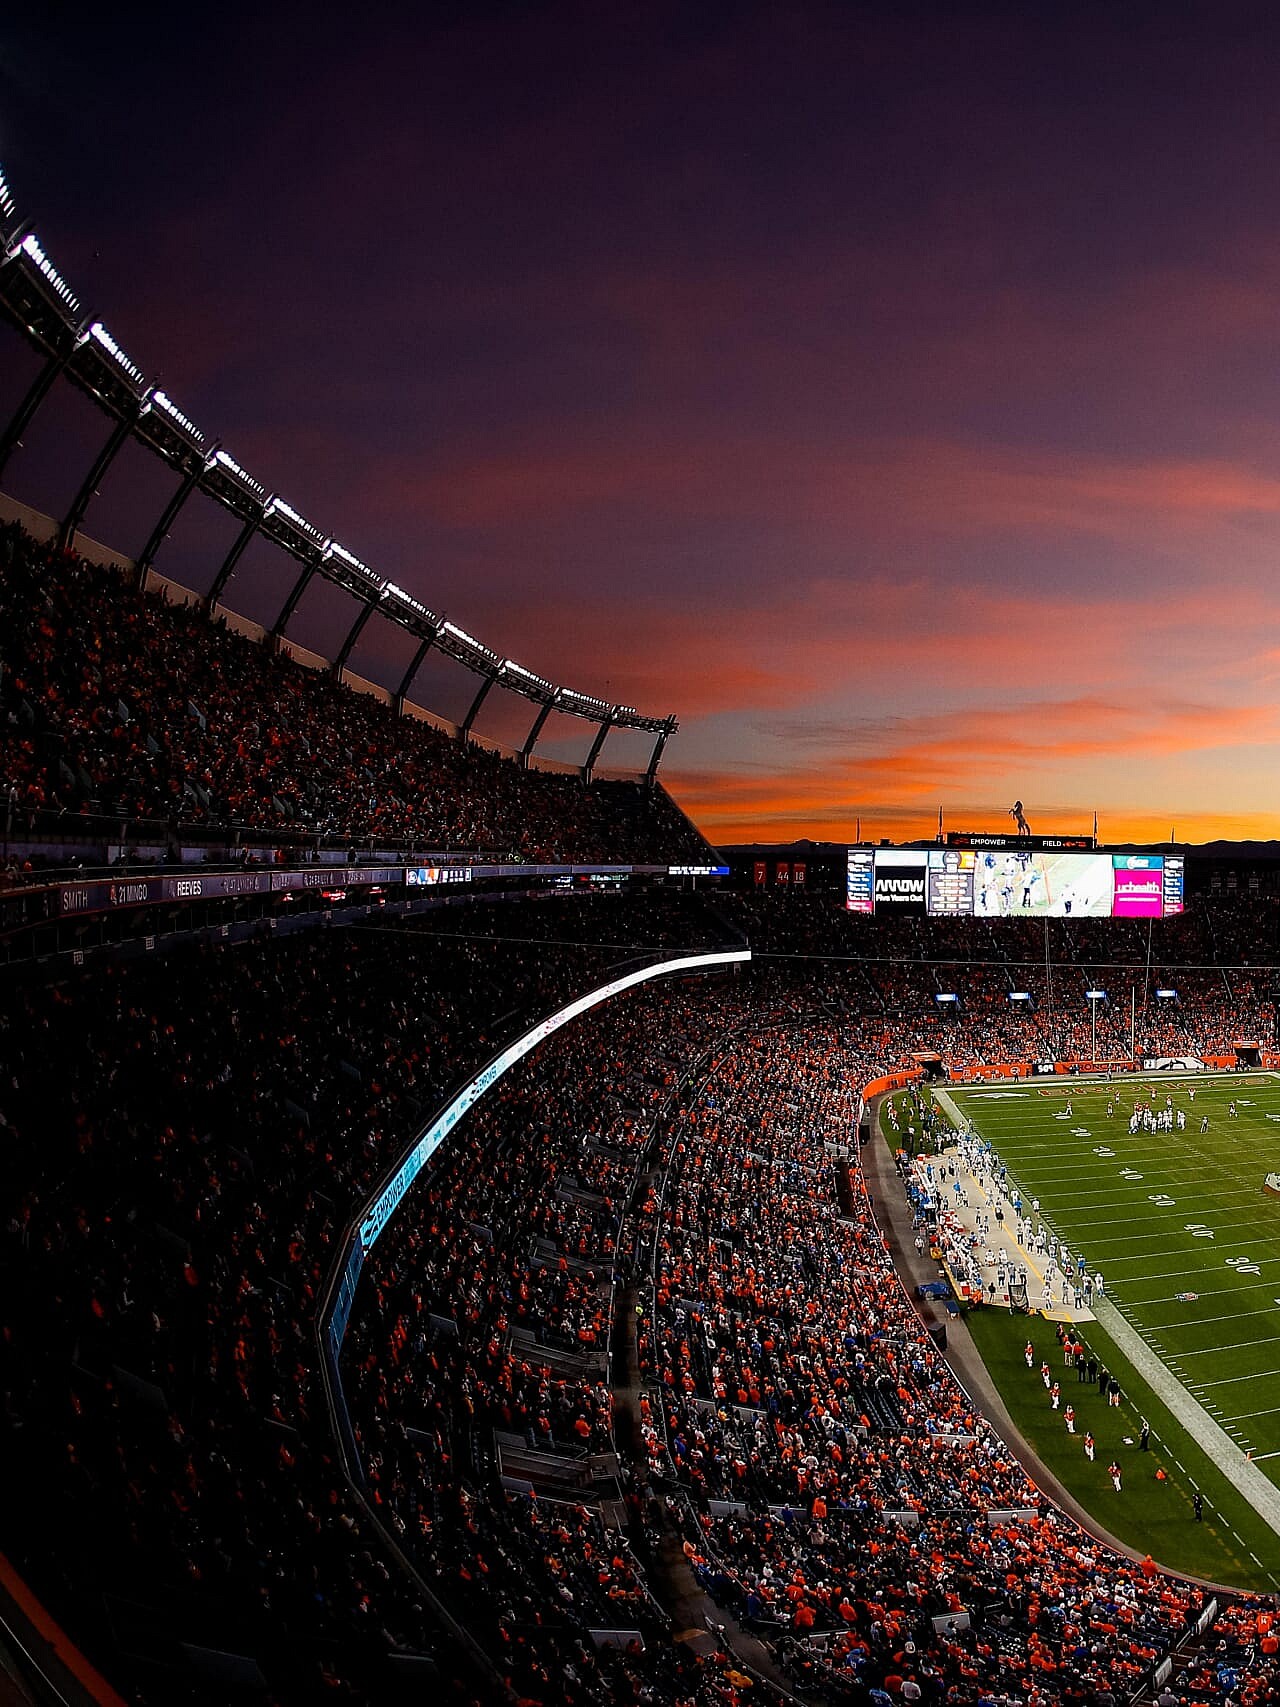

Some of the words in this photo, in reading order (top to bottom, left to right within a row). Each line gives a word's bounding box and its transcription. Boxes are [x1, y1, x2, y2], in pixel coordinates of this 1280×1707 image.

[970, 838, 1006, 846] EMPOWER
[177, 880, 202, 896] REEVES
[876, 879, 924, 892] ARROW
[1118, 881, 1160, 892] uchealth
[126, 884, 148, 902] MINGO
[63, 890, 88, 911] SMITH
[1148, 1194, 1176, 1206] 50
[1184, 1224, 1214, 1237] 40
[1225, 1256, 1260, 1273] 30
